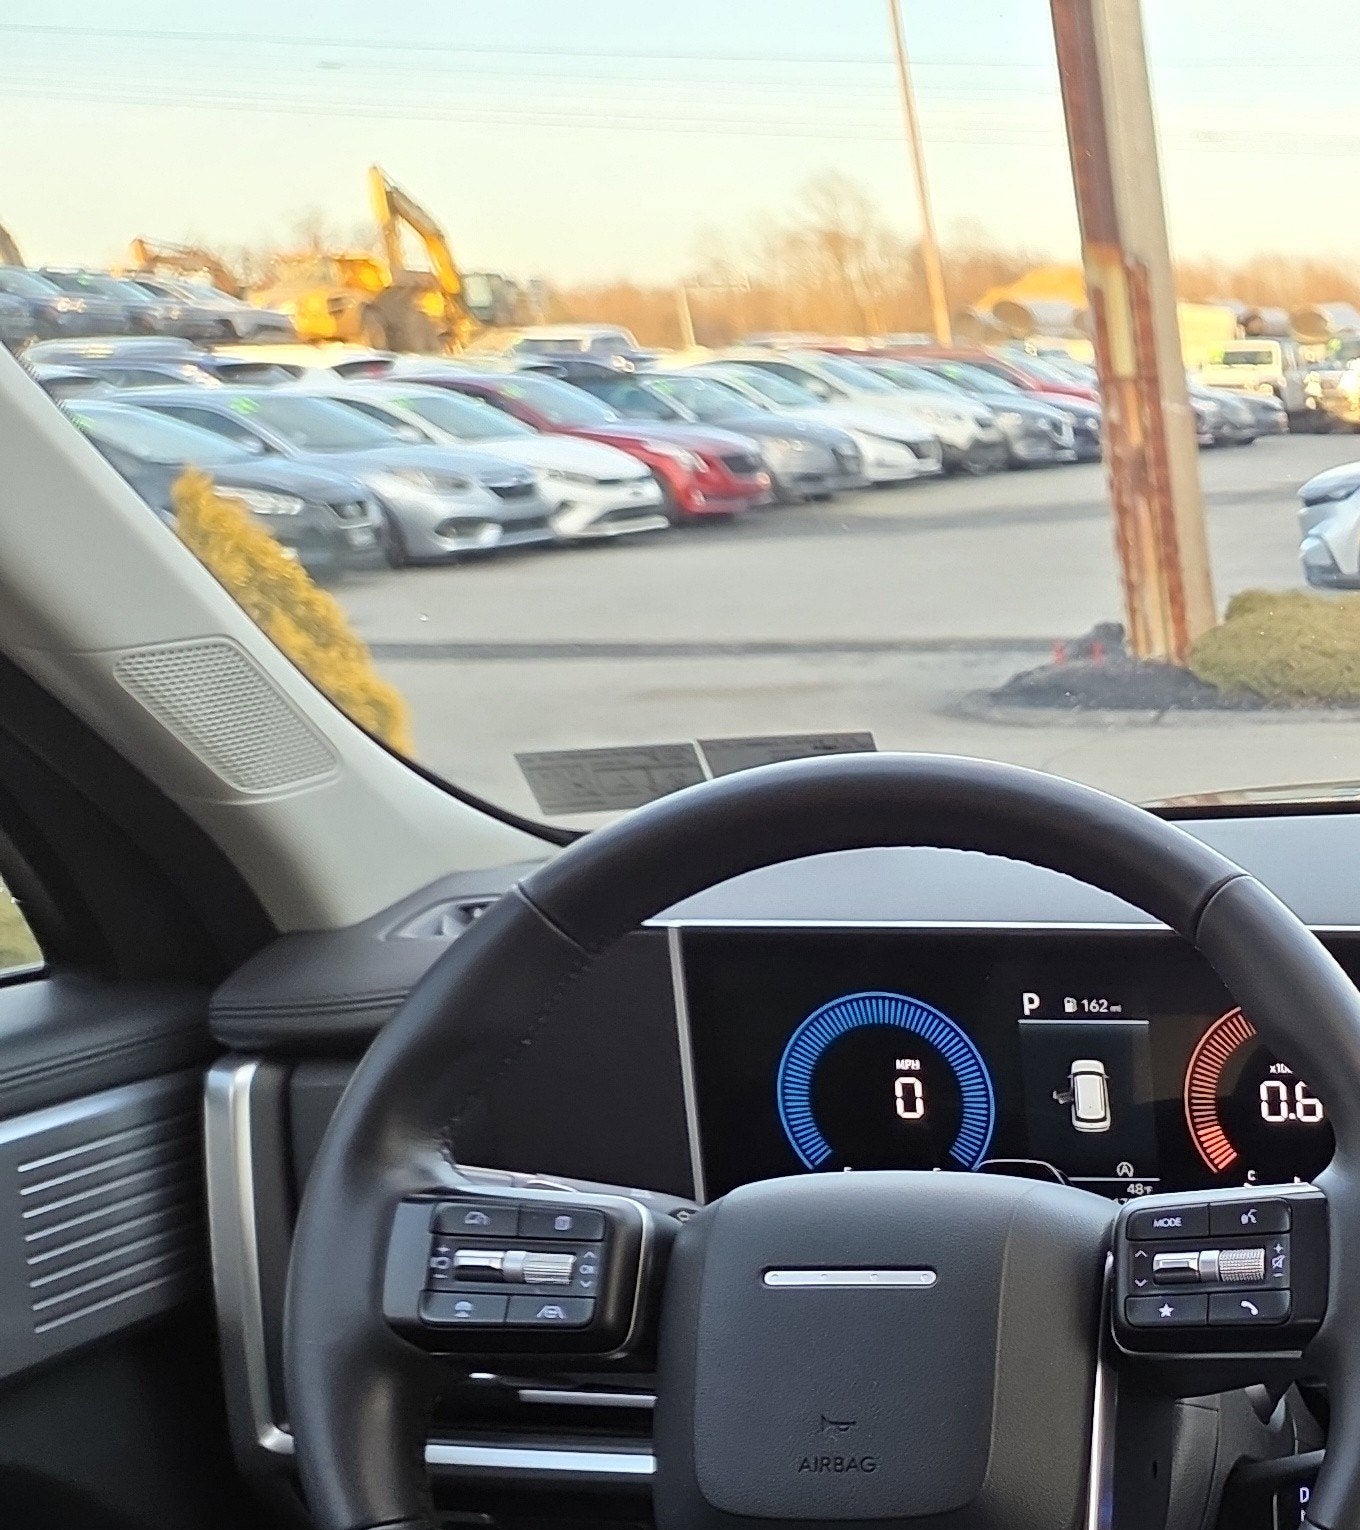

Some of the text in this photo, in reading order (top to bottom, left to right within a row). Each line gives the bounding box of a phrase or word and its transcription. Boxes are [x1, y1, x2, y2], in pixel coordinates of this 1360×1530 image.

[1022, 992, 1040, 1016] P
[1081, 998, 1109, 1013] 162
[895, 1058, 921, 1071] MPH
[894, 1076, 925, 1119] 0
[1259, 1080, 1324, 1123] 0.6
[1247, 1169, 1257, 1181] C
[1152, 1216, 1183, 1228] MODE
[797, 1456, 878, 1473] AIRBAG
